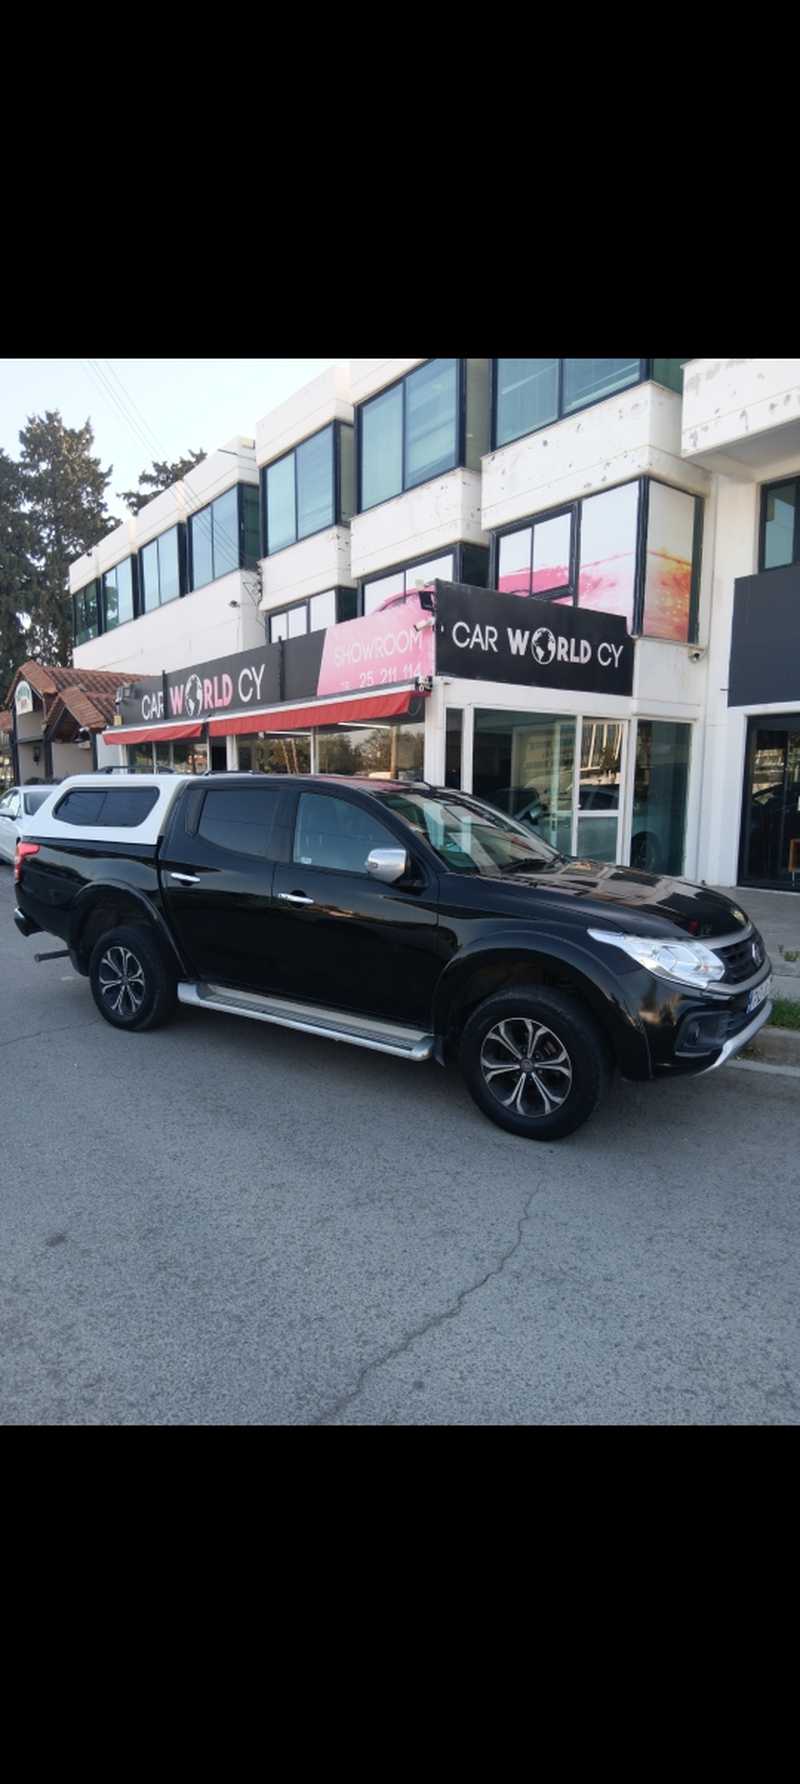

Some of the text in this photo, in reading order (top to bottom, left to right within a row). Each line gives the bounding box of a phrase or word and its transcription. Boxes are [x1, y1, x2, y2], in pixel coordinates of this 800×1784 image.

[334, 626, 422, 667] SHOWROOM
[452, 621, 498, 652] CAR
[597, 642, 624, 668] CY
[238, 664, 265, 702] CY
[359, 670, 375, 688] 25
[380, 665, 397, 684] 211
